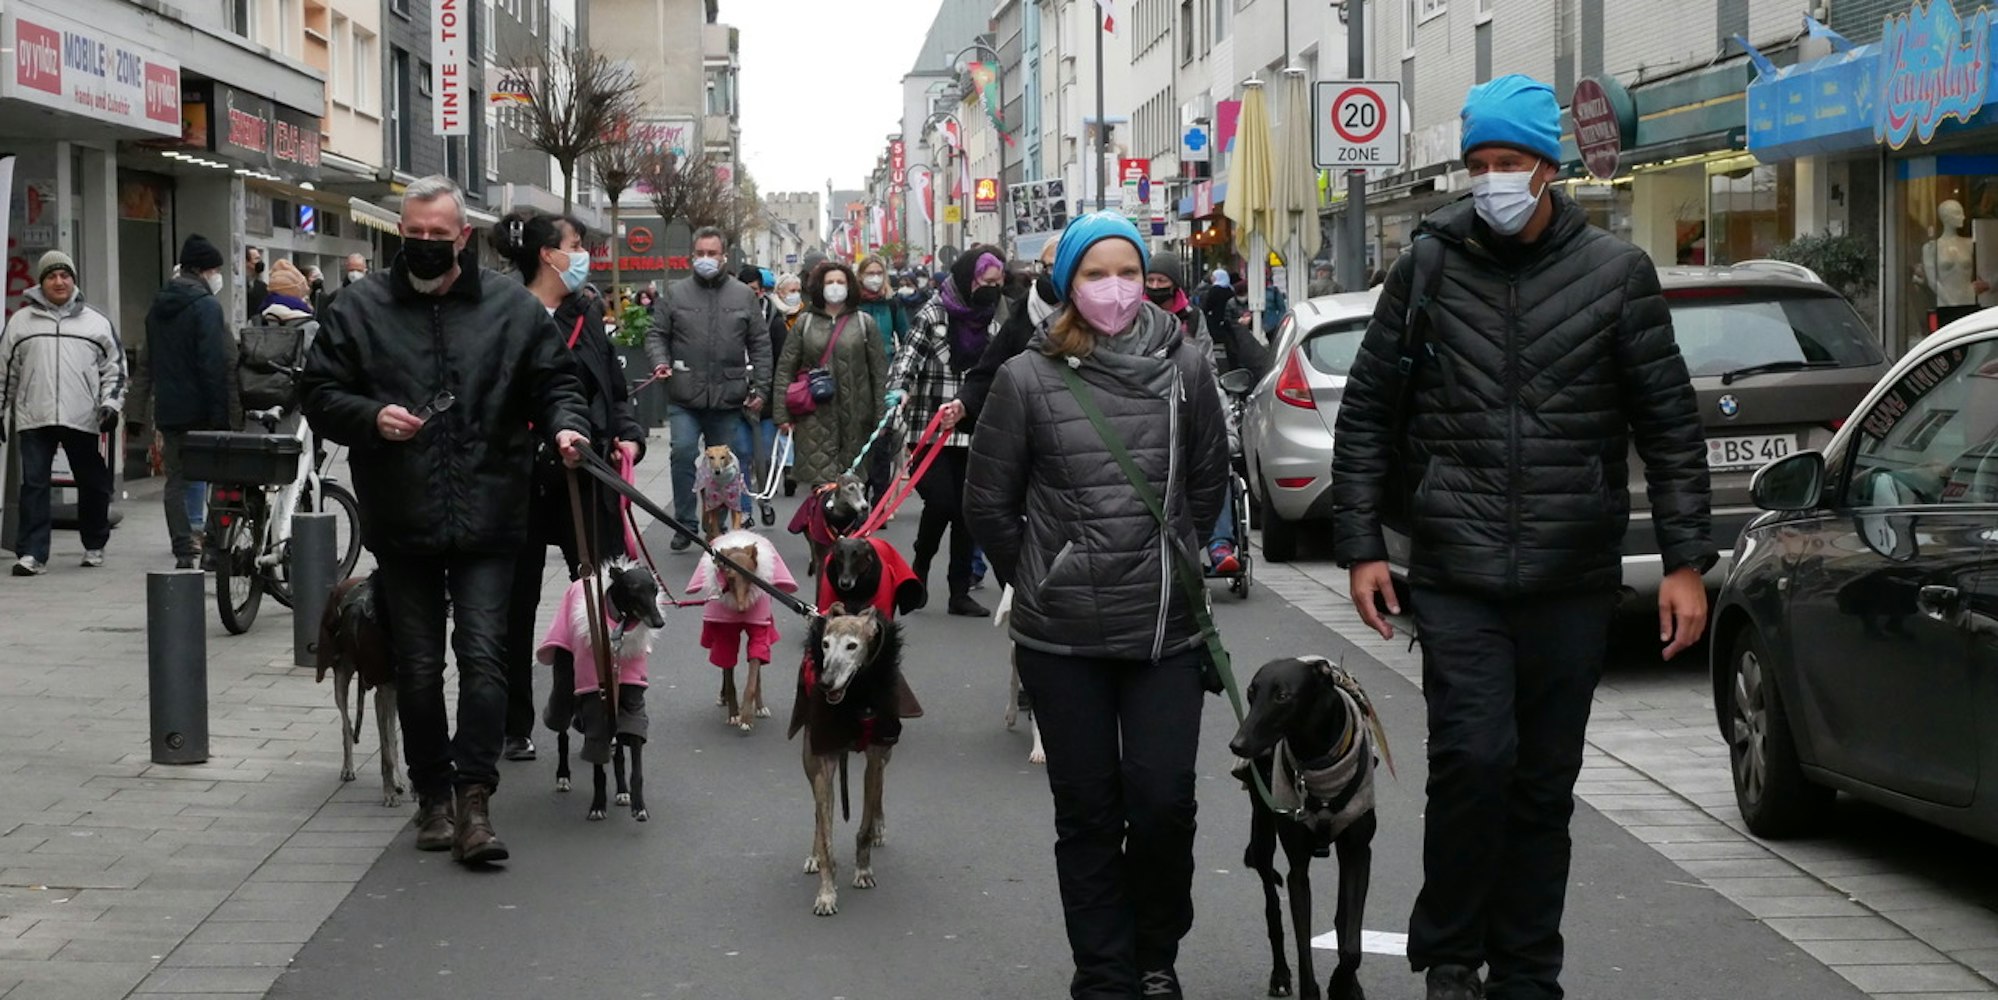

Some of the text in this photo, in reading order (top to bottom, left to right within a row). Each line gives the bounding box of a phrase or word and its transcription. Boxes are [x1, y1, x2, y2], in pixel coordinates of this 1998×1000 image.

[441, 0, 456, 42] TON
[64, 31, 141, 88] MOBILE ZONE
[95, 90, 107, 110] und
[442, 64, 458, 130] TINTE
[1345, 103, 1375, 128] 20
[1338, 147, 1380, 161] ZONE
[1725, 440, 1755, 462] BS
